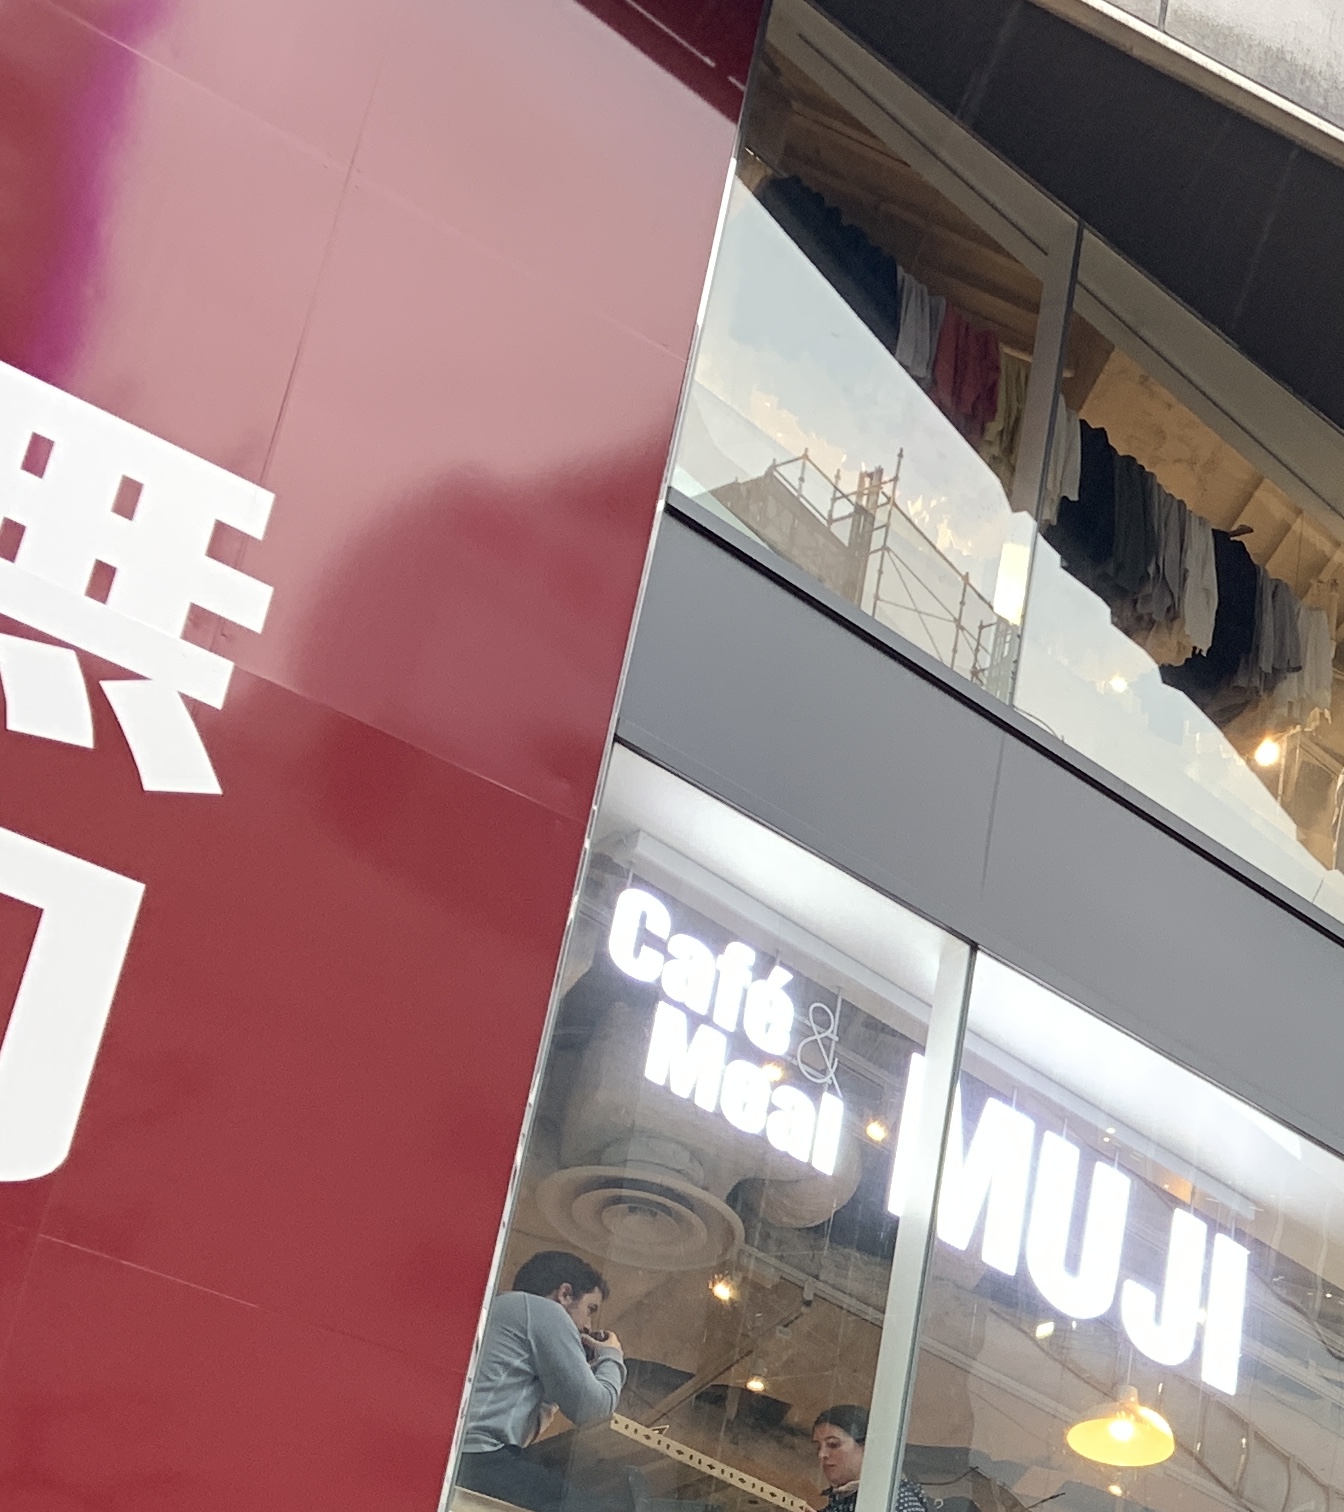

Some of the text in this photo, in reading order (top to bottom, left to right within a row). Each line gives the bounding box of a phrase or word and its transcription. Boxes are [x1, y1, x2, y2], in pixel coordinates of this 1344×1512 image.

[609, 887, 844, 1097] Café &
[644, 1001, 1250, 1395] Meal MUJI
